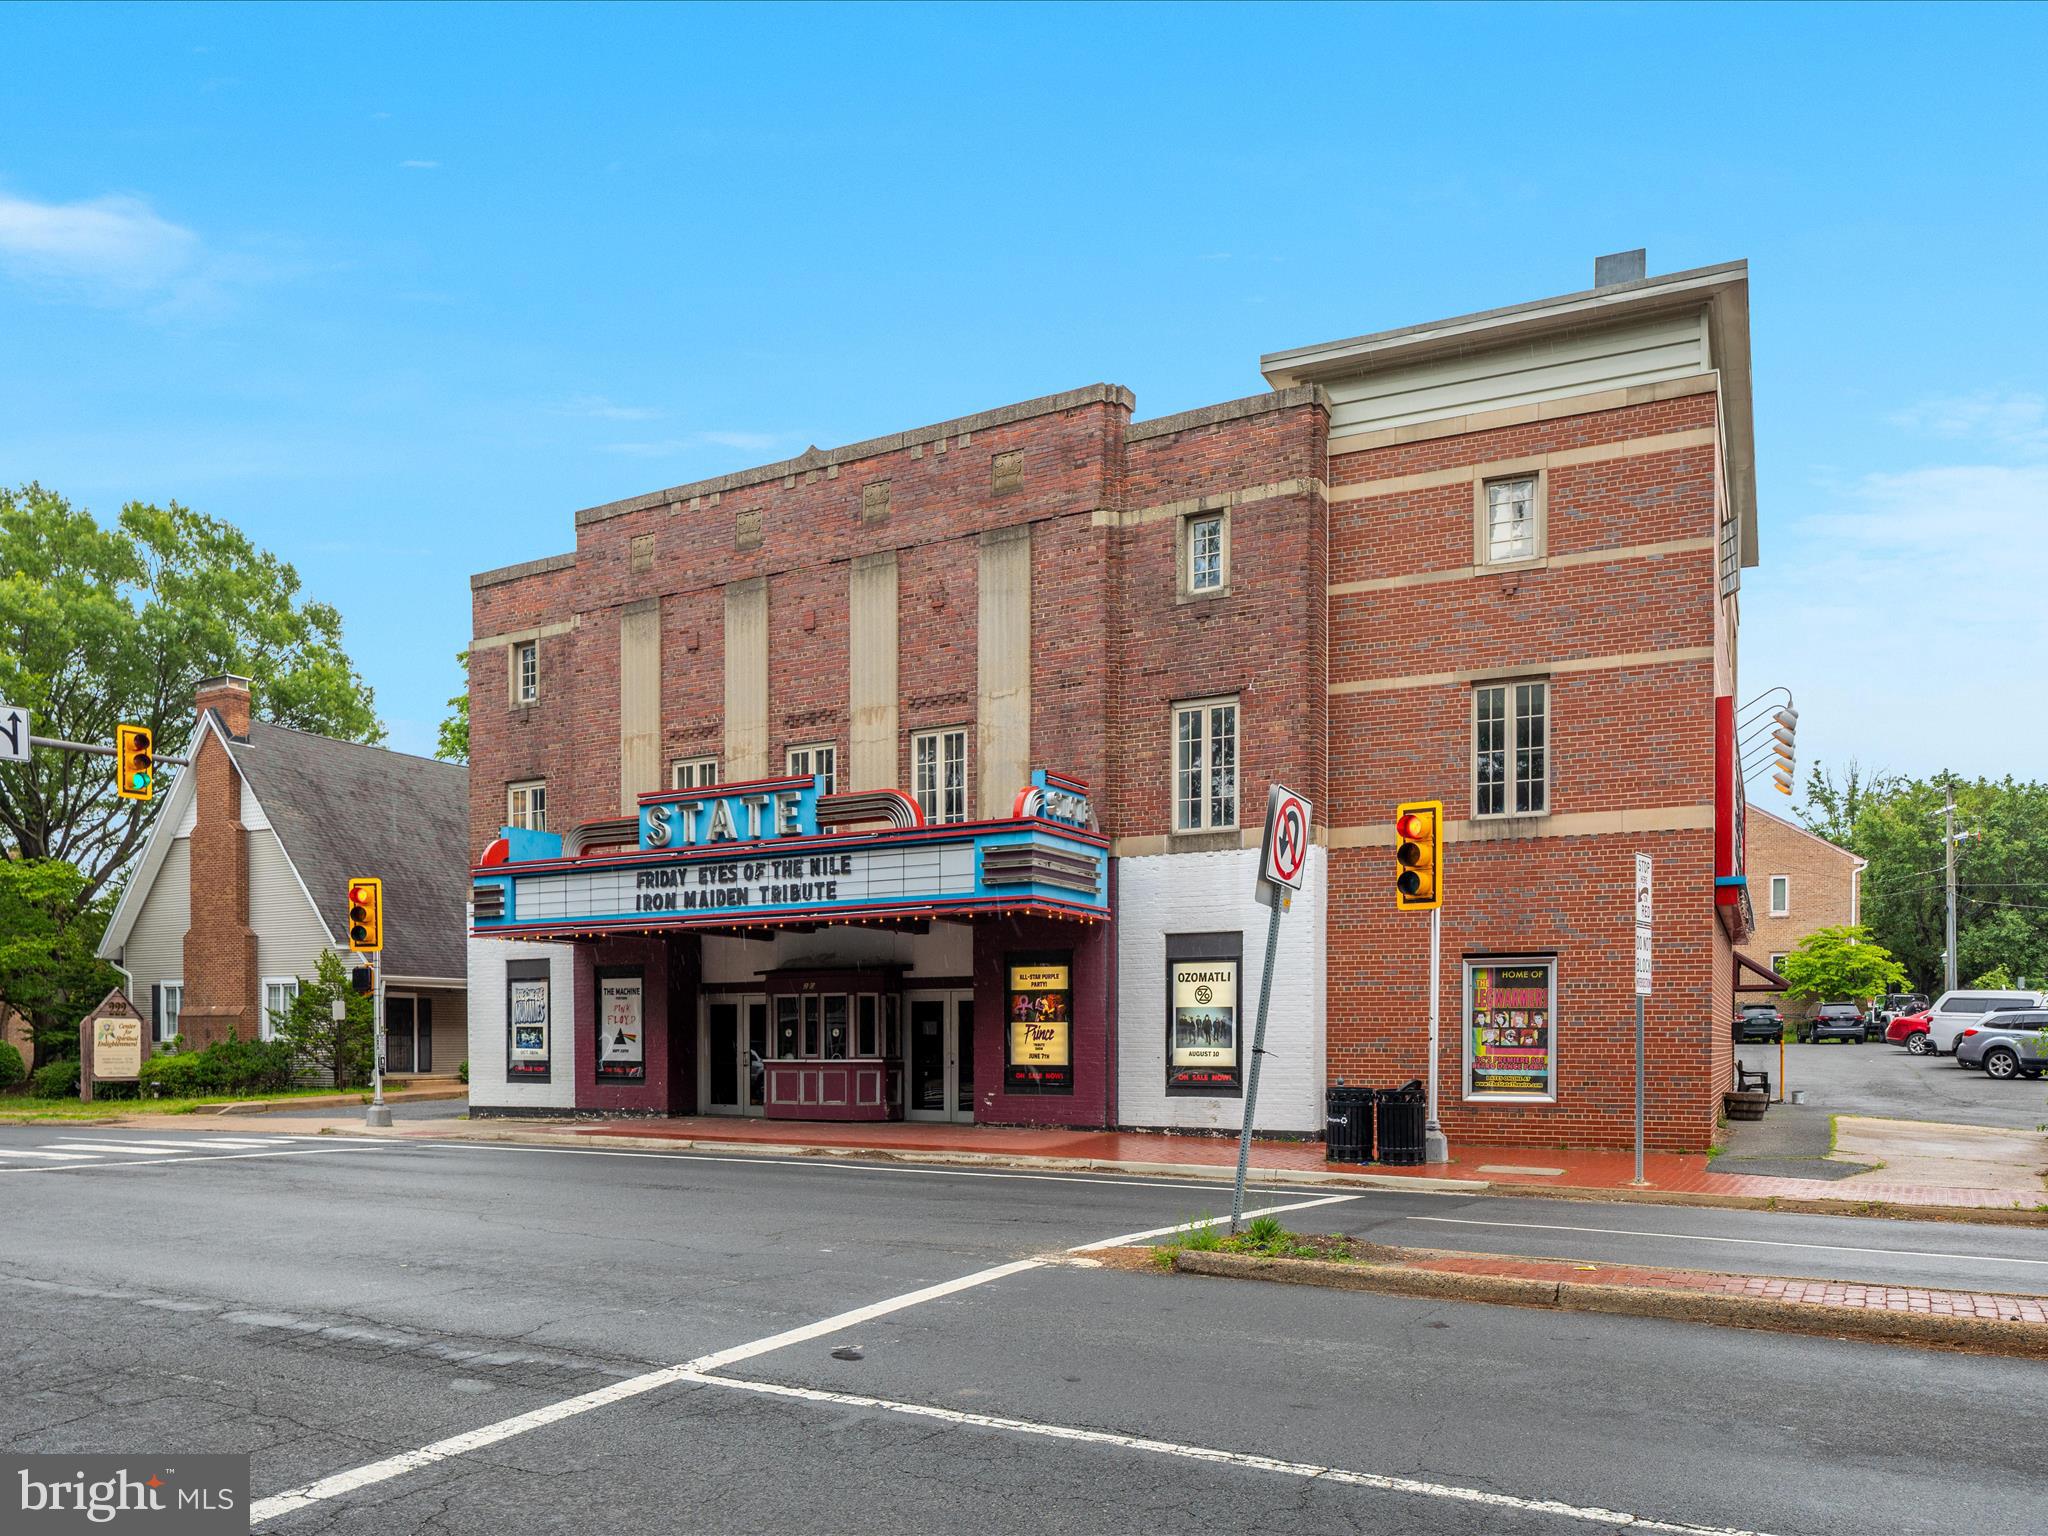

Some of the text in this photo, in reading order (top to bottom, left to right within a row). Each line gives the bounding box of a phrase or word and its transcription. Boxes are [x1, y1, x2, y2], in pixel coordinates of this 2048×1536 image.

[646, 792, 802, 847] STATE
[636, 855, 852, 889] FRIDAY EYES OF THE NILE
[1638, 859, 1650, 874] STOP
[636, 881, 837, 912] IRON MAIDEN TRIBUTE
[1641, 904, 1650, 918] RED
[1177, 972, 1231, 983] OZOMATLI
[1475, 980, 1488, 988] THE
[604, 987, 640, 996] THE MACHINE
[108, 1002, 127, 1016] 222
[614, 1004, 630, 1014] PINK
[607, 1015, 637, 1025] FLOYD
[1024, 1024, 1055, 1045] Prince
[1493, 1056, 1529, 1064] PREMIERE
[1524, 1063, 1547, 1071] PARTY
